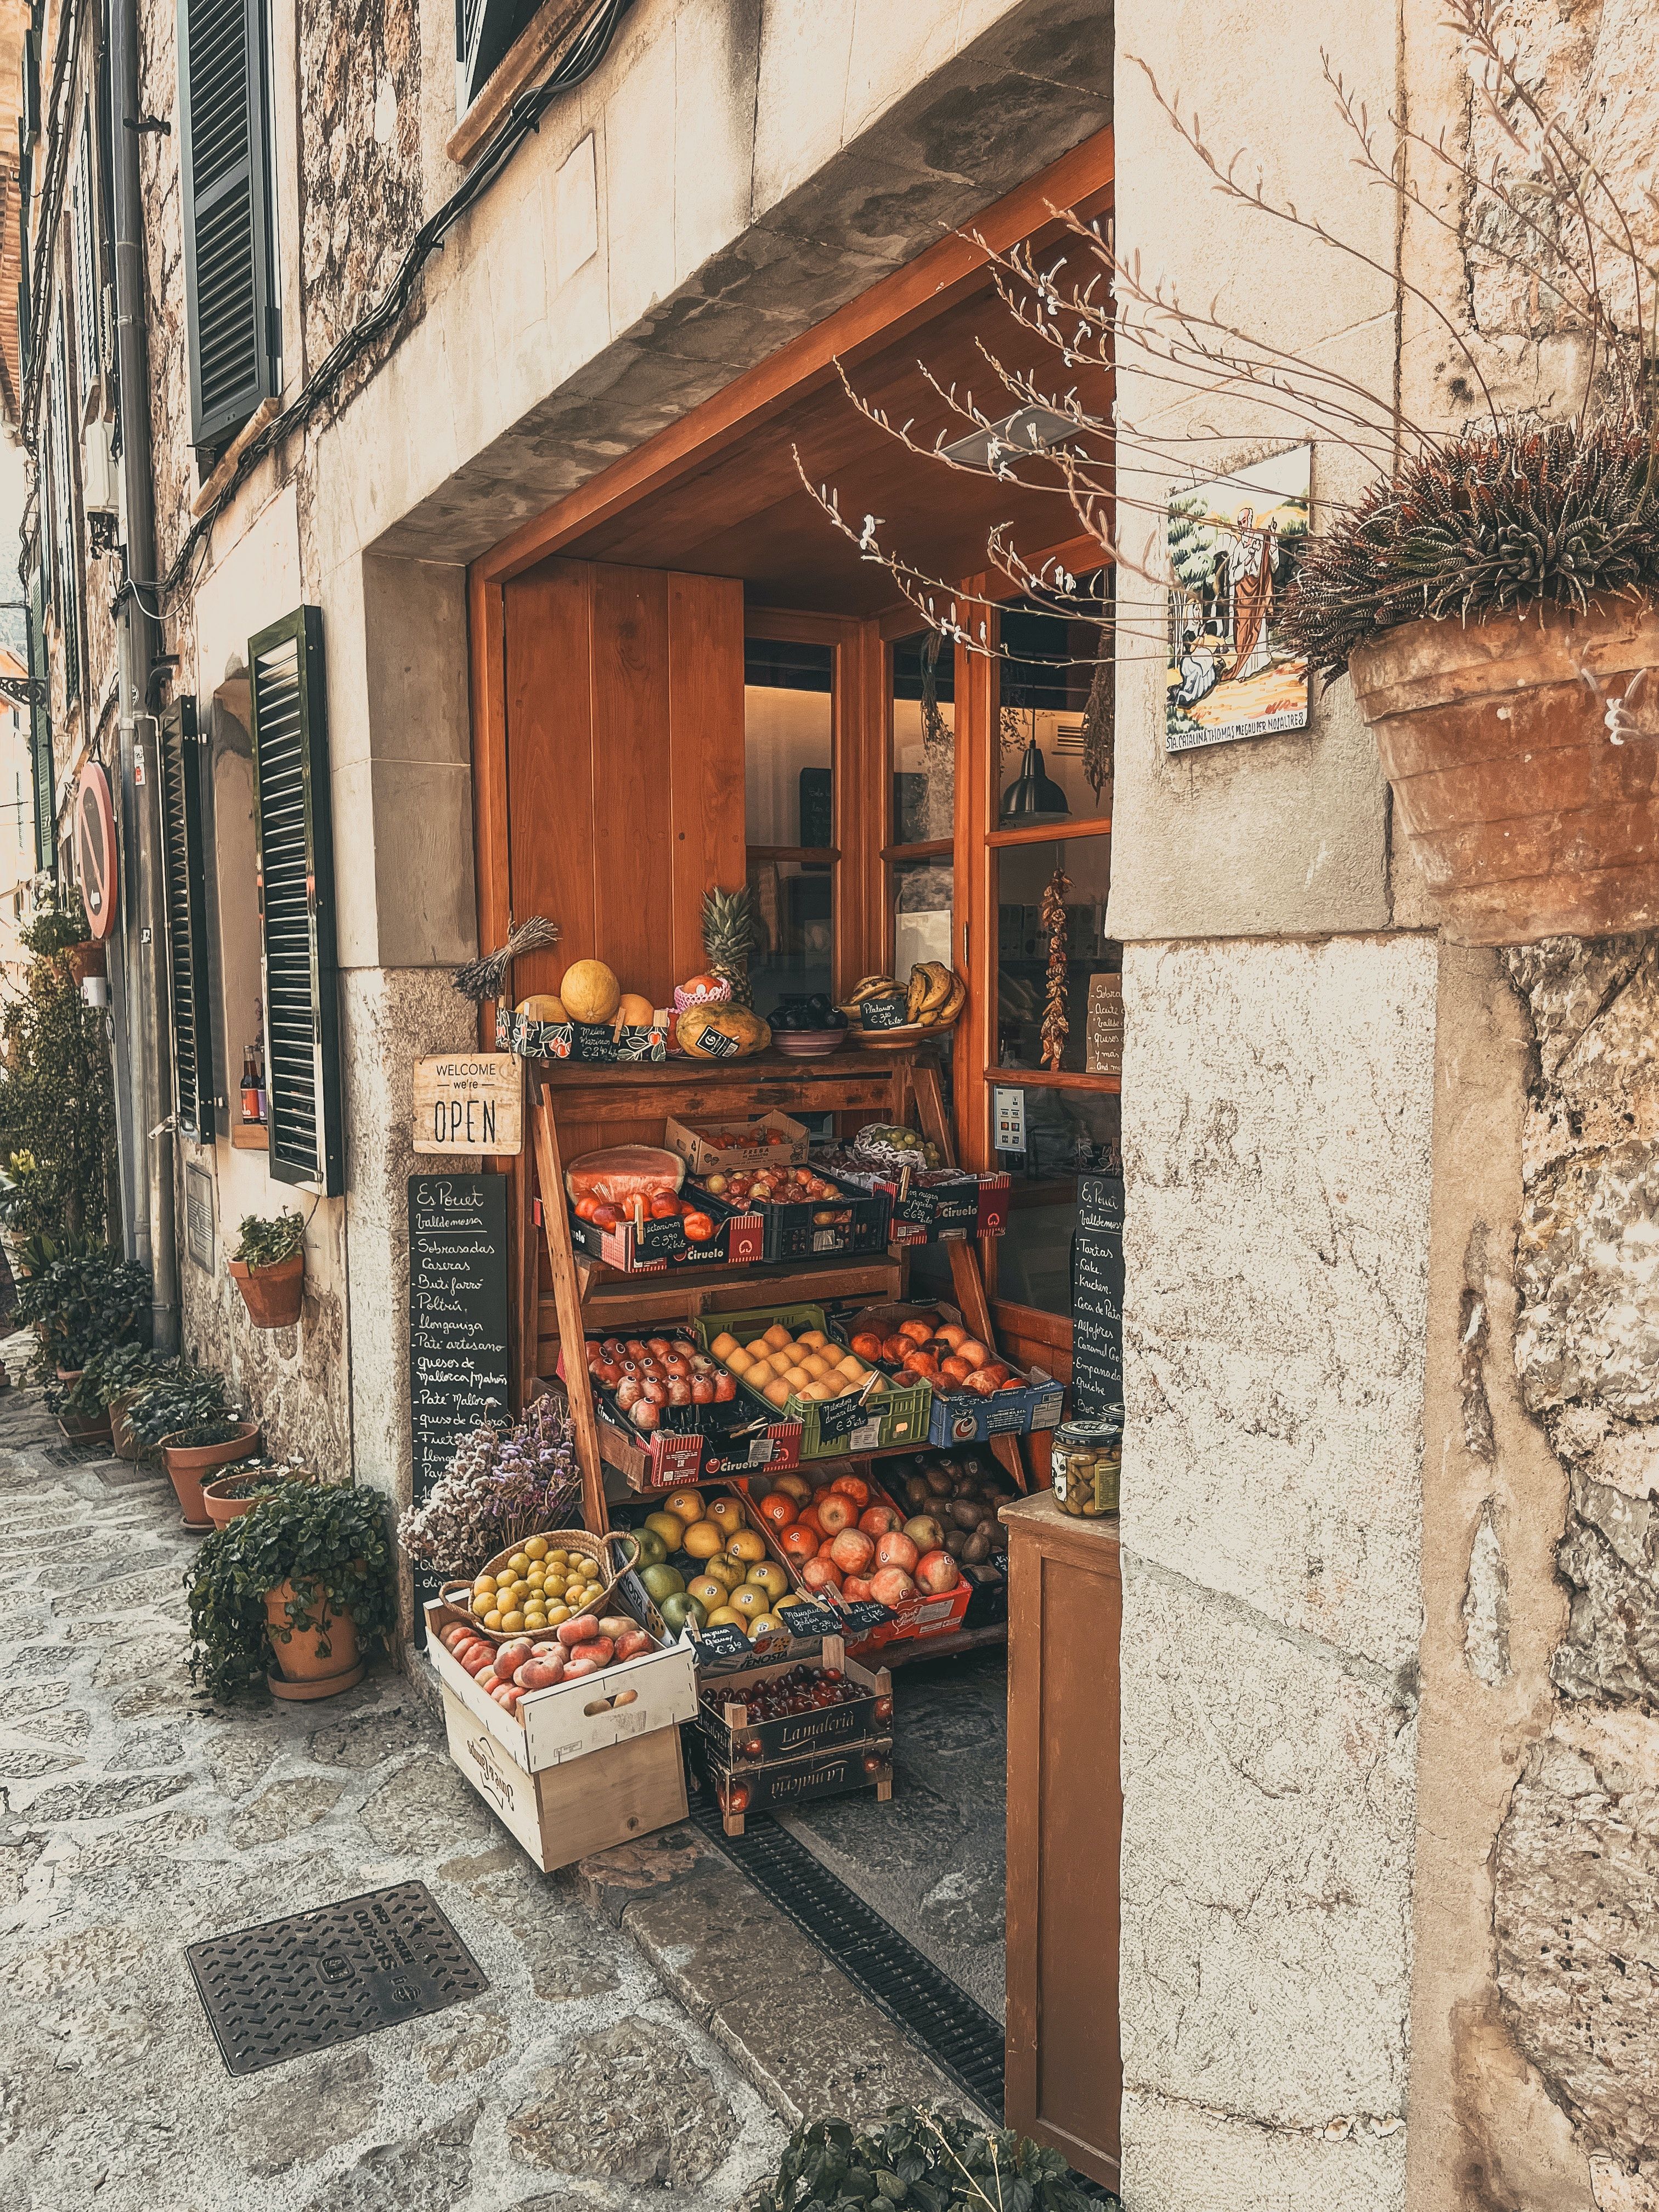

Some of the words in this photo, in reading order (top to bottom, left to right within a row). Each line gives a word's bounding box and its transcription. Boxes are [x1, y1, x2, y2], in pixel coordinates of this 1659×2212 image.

[1178, 729, 1207, 748] CATALINA
[1207, 725, 1235, 743] THOMAS
[436, 1063, 496, 1076] WELCOME
[453, 1079, 478, 1089] we're
[435, 1099, 495, 1144] OPEN
[417, 1183, 437, 1206] Es
[1081, 1182, 1092, 1203] Es
[943, 1206, 978, 1217] Ciruelo
[415, 1213, 483, 1229] Valldemossa
[1080, 1209, 1123, 1230] Valldemoss
[417, 1238, 495, 1255] Sobrasadas
[1079, 1238, 1114, 1259] Tartas
[687, 1249, 724, 1260] Ciruelo
[422, 1257, 471, 1271] Caseras
[1095, 1302, 1104, 1315] de
[445, 1336, 506, 1352] artesano
[461, 1357, 475, 1369] de
[419, 1389, 450, 1406] Paté
[453, 1413, 466, 1425] de
[417, 1431, 456, 1446] Fuet
[720, 1461, 759, 1472] Ciruelo
